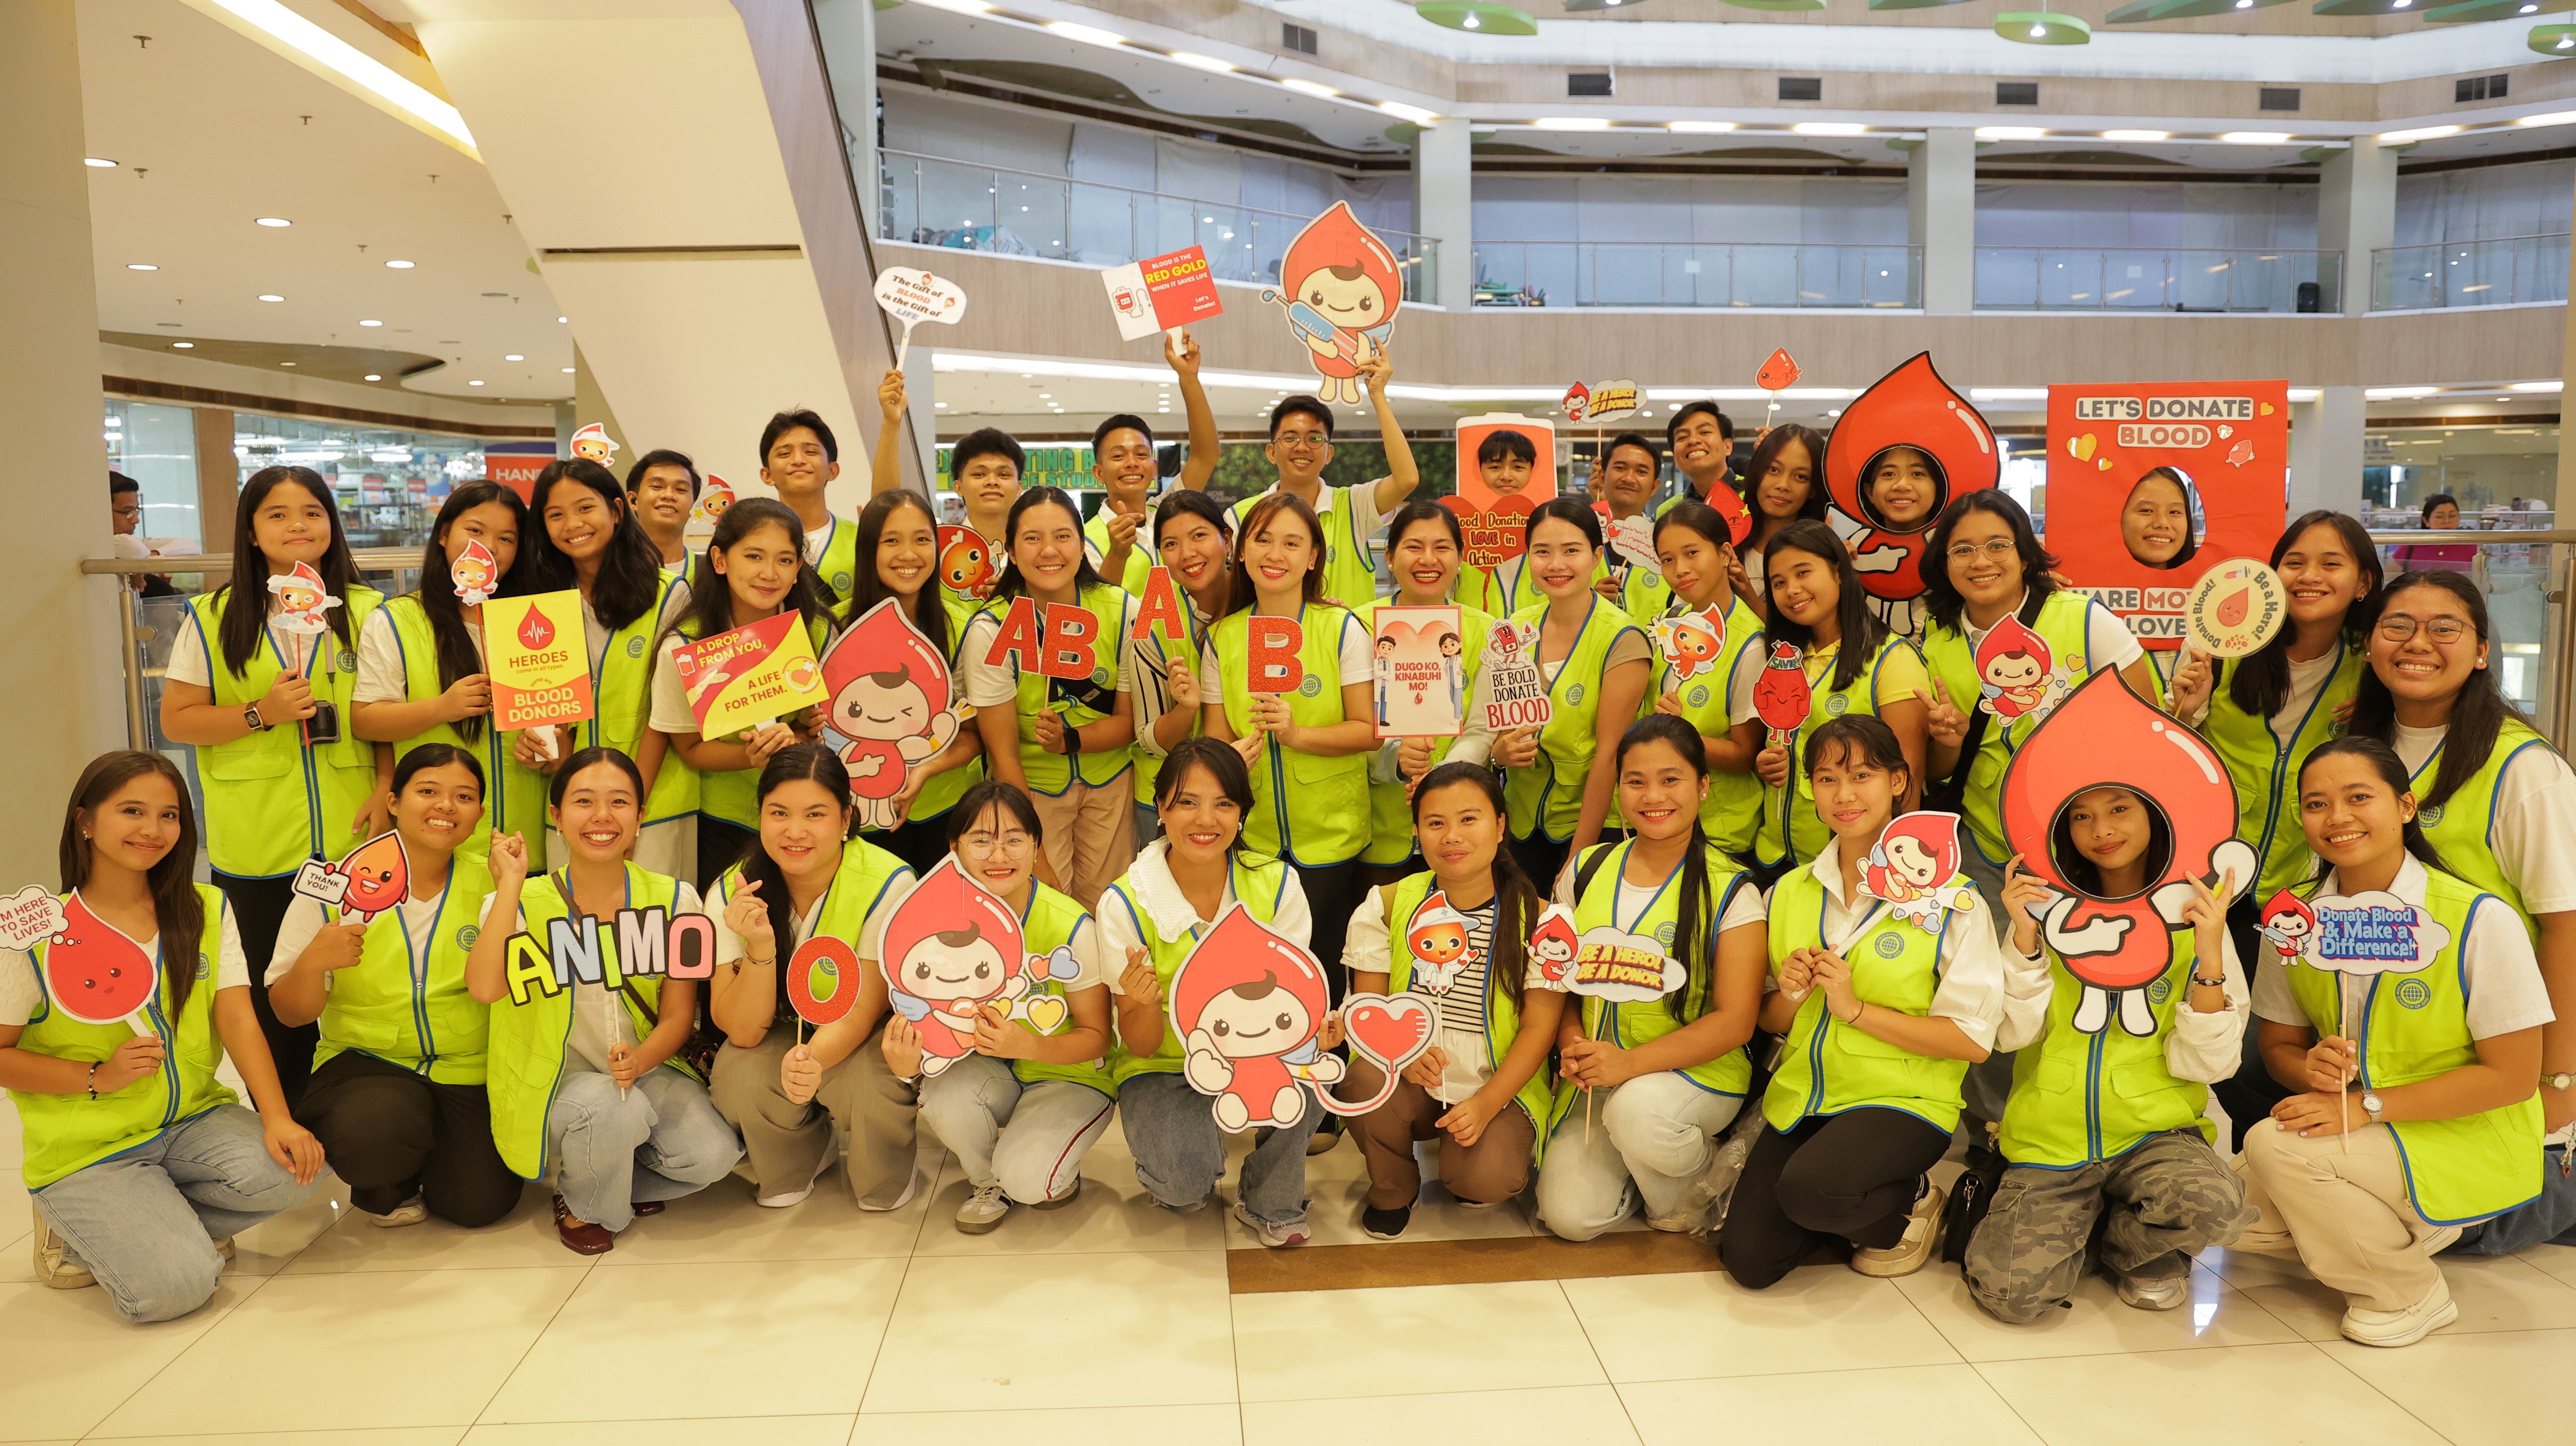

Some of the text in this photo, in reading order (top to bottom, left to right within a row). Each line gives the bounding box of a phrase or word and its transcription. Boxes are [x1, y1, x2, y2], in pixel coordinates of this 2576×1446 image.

[1151, 259, 1173, 269] BLOOD
[1179, 253, 1192, 261] THE
[1145, 259, 1207, 284] RED GOLD
[893, 275, 911, 286] The
[912, 283, 931, 293] Gift
[1151, 283, 1170, 292] WHEN
[1177, 276, 1195, 286] SAVES
[1196, 272, 1208, 280] LIFE
[893, 297, 909, 306] the
[911, 303, 929, 313] Gift
[896, 288, 930, 304] BLOOD
[896, 308, 919, 320] LIFE
[1193, 301, 1216, 312] Donate!
[1589, 388, 1636, 405] BE A HERO!
[1589, 402, 1601, 416] BE
[1599, 400, 1607, 411] A
[2079, 400, 2250, 417] LET'S DONATE
[2120, 427, 2209, 445] BLOOD
[1470, 531, 1516, 546] LOVE in
[1468, 550, 1502, 566] Action
[1130, 565, 1185, 641] A
[2251, 571, 2278, 641] Be a Hero!
[2193, 579, 2221, 649] Donate Blood!
[2126, 618, 2186, 635] LOVE
[696, 633, 740, 655] A DROP
[984, 595, 1099, 680] AB
[510, 651, 568, 668] HEROES
[699, 638, 766, 668] FROM YOU,
[1248, 616, 1303, 694] B
[1395, 662, 1441, 672] DUGO KO,
[1395, 671, 1441, 681] KINABUHI
[530, 678, 543, 687] some
[748, 671, 781, 690] A LIFE
[1409, 682, 1428, 690] MO!
[1492, 669, 1535, 687] BE BOLD
[513, 687, 574, 707] BLOOD
[725, 684, 787, 712] FOR THEM.
[1494, 683, 1539, 702] DONATE
[508, 700, 582, 723] DONORS
[1486, 698, 1549, 728] BLOOD
[307, 880, 328, 891] YOU!
[311, 873, 340, 887] THANK
[14, 896, 48, 916] HERE
[2319, 907, 2413, 922] Donate Blood
[0, 906, 53, 934] TO SAVE
[13, 919, 52, 941] LIVES!
[2324, 921, 2409, 939] & Make a
[505, 906, 715, 1006] ANIMO
[2321, 938, 2414, 956] Difference!
[1577, 944, 1664, 973] BE A HERO!
[1575, 963, 1663, 990] BE A DONOR
[2397, 996, 2414, 1009] CHURCH
